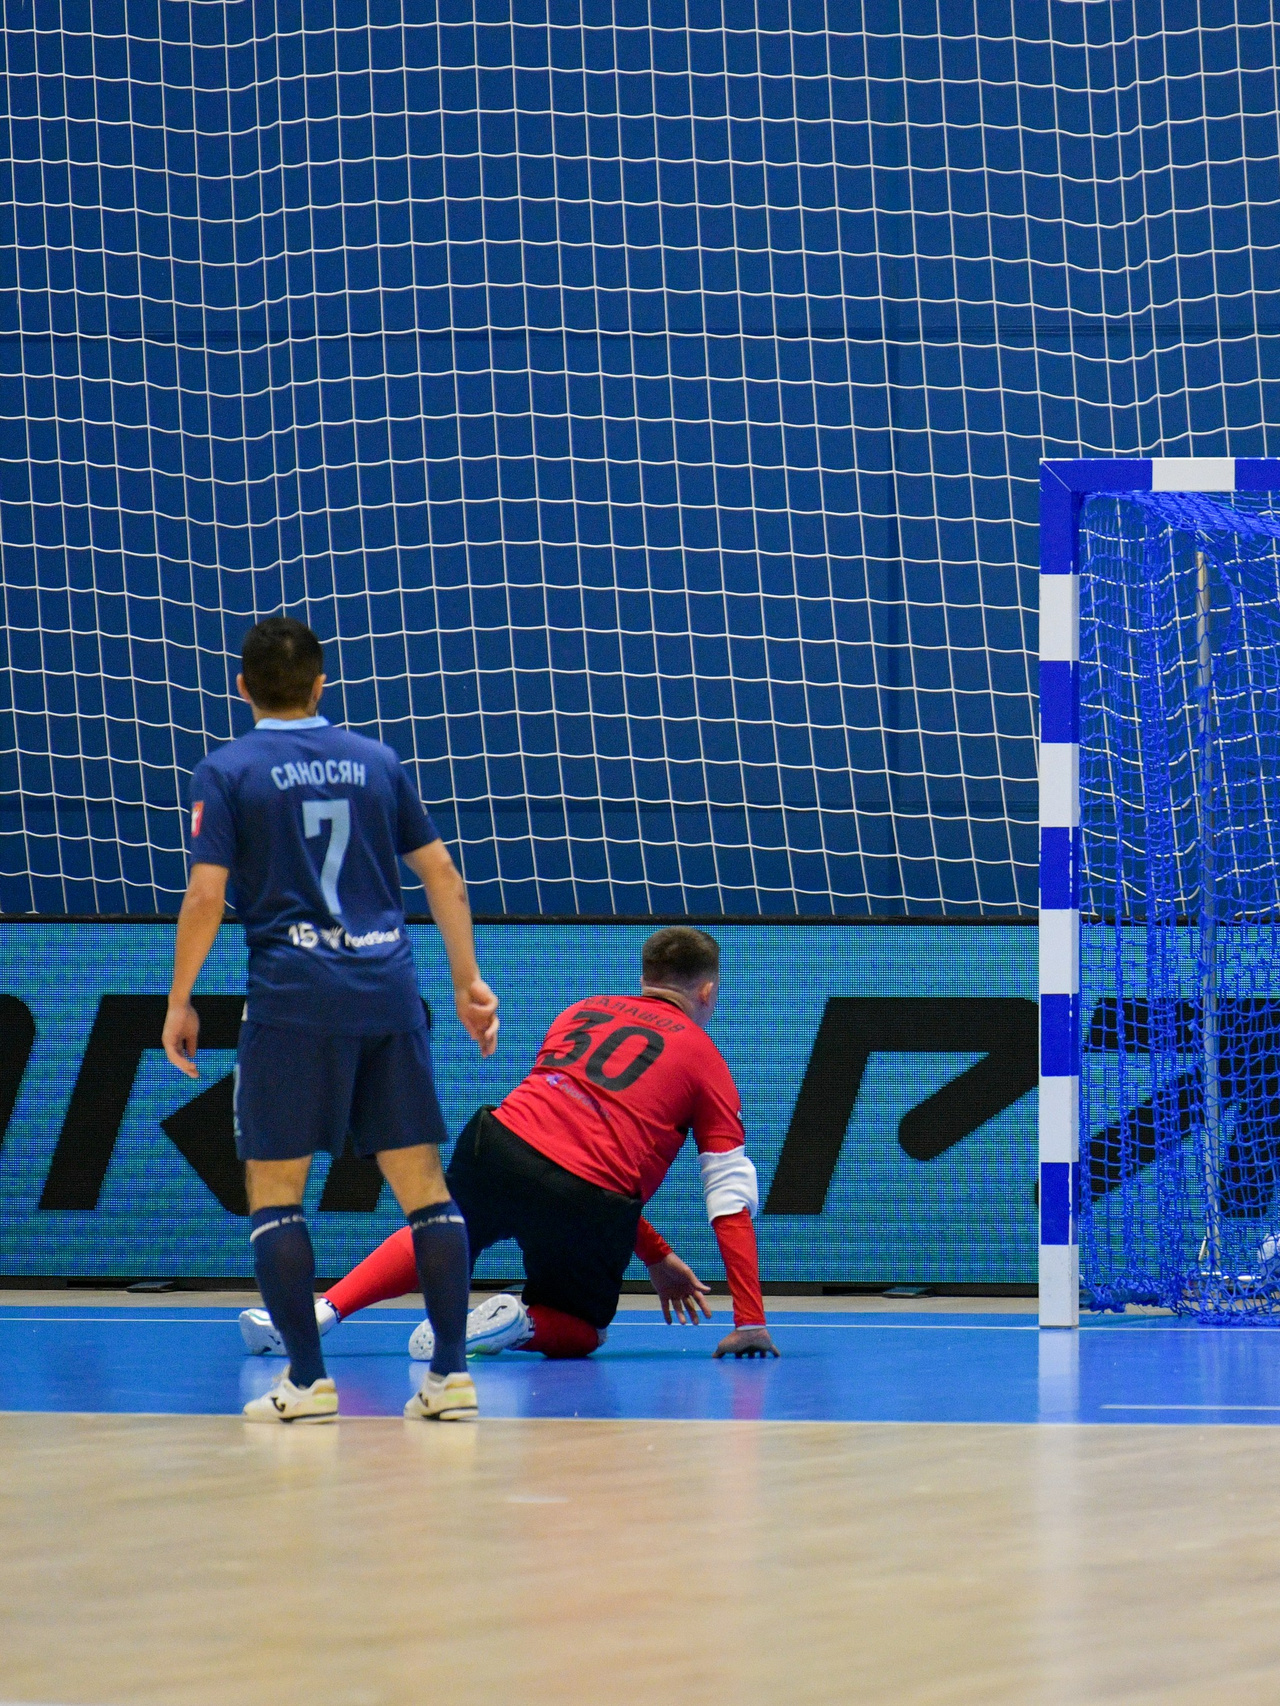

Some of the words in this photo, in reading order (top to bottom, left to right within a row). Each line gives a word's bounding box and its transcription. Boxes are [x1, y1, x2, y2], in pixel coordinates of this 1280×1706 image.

[270, 759, 366, 790] САНОСЯН
[301, 798, 350, 915] 7
[288, 921, 319, 949] 15
[540, 1010, 665, 1092] 30
